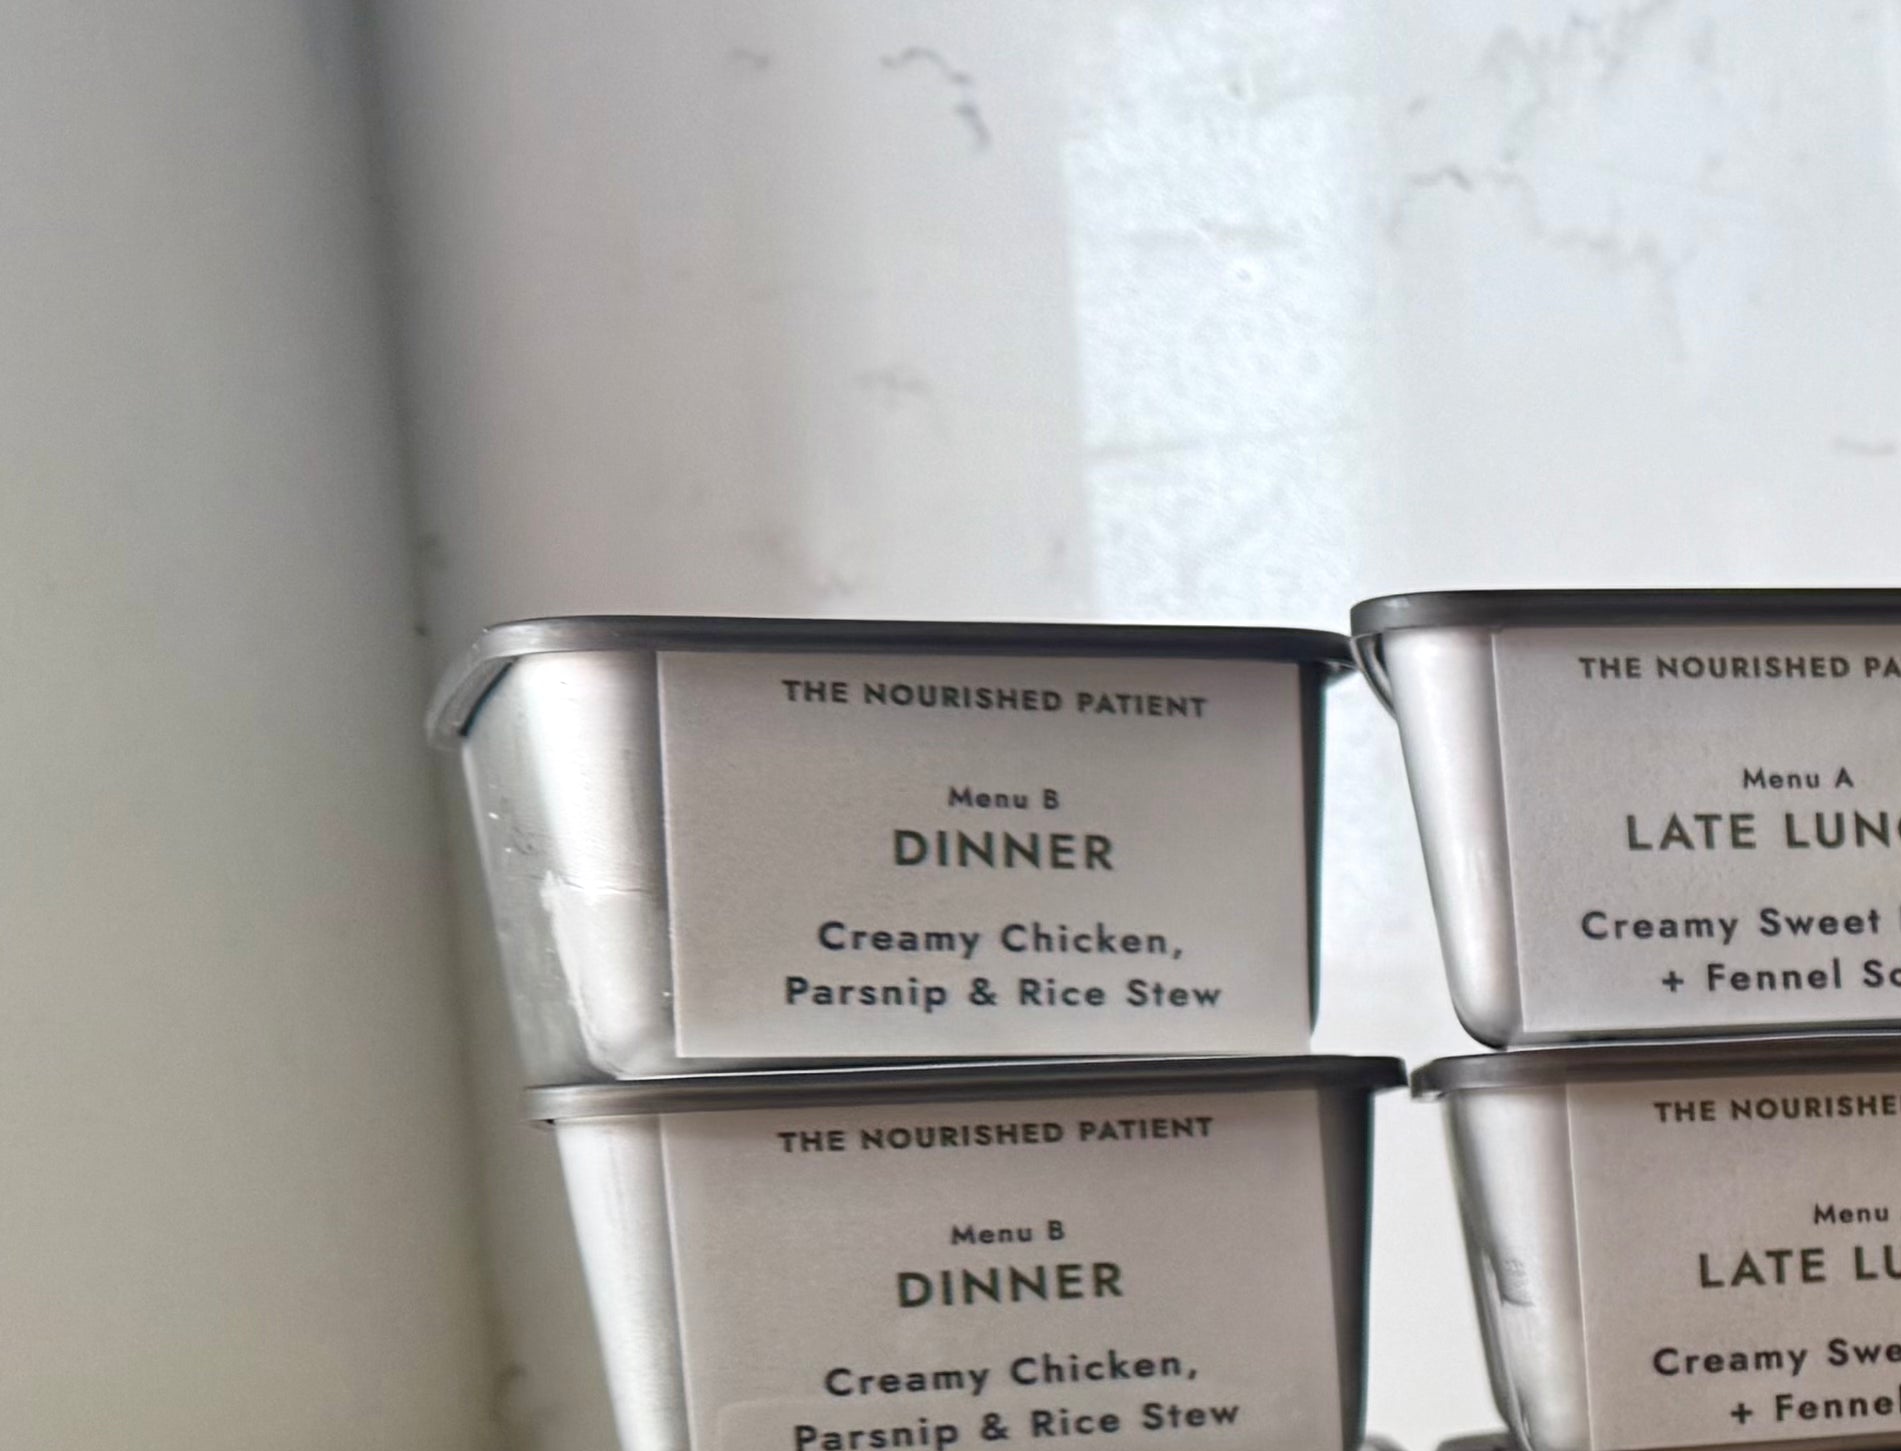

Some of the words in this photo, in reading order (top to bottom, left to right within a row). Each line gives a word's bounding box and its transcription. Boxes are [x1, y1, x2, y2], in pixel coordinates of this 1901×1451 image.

[1578, 657, 1641, 679] THE
[1656, 656, 1850, 678] NOURISHED
[782, 680, 848, 703] THE
[864, 683, 1062, 711] NOURISHED
[1077, 692, 1207, 717] PATIENT
[1743, 768, 1819, 789] Menu
[1835, 767, 1853, 788] A
[947, 787, 1028, 812] Menu
[1043, 789, 1059, 810] B
[1627, 813, 1756, 850] LATE
[894, 830, 1112, 870] DINNER
[818, 921, 980, 960] Creamy
[1000, 922, 1182, 959] Chicken,
[1581, 911, 1738, 945] Creamy
[1760, 908, 1880, 936] Sweet
[1662, 971, 1684, 992] +
[1707, 958, 1841, 991] Fennel
[786, 976, 947, 1013] Parsnip
[969, 978, 996, 1006] &
[1019, 978, 1105, 1006] Rice
[1127, 979, 1221, 1007] Stew
[1653, 1347, 1807, 1376] Creamy
[1731, 1403, 1753, 1424] +
